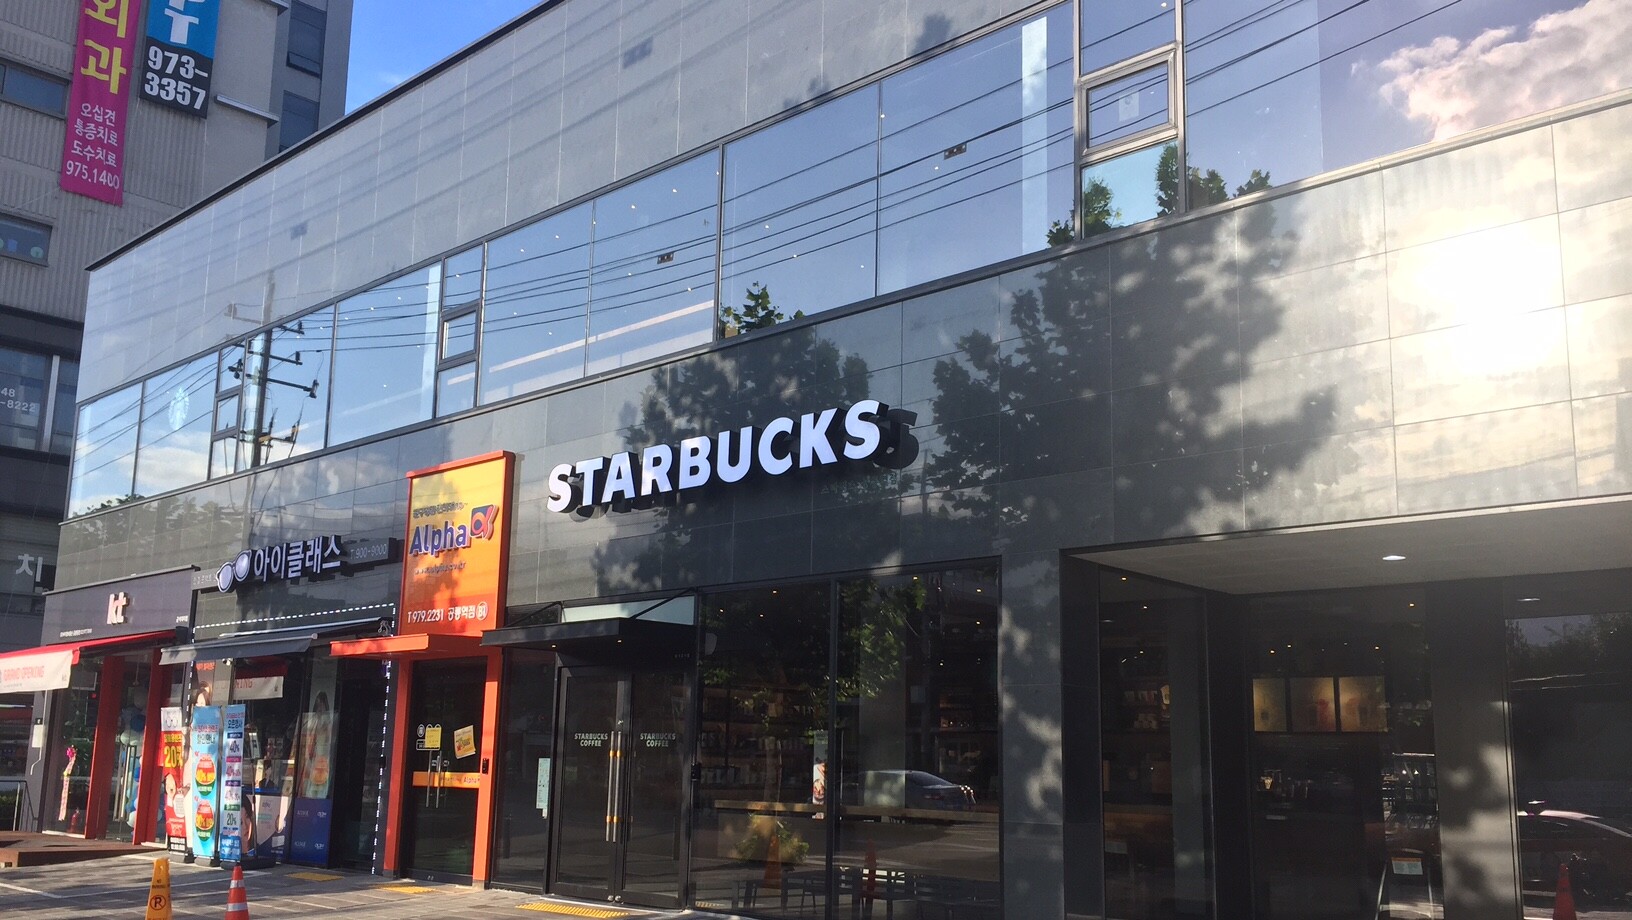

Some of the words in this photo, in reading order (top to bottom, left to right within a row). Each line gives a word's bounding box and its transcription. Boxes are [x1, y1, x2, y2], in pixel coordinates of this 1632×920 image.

[147, 46, 208, 80] 973-
[144, 72, 206, 110] 3357
[74, 118, 118, 146] 통증치료
[81, 103, 116, 127] 오십견
[71, 140, 117, 167] 도수치료
[66, 160, 120, 189] 975.1400
[547, 400, 880, 513] STARBUCKS
[409, 520, 468, 556] Alpha
[254, 535, 342, 582] 아이클래스
[107, 591, 127, 625] kt
